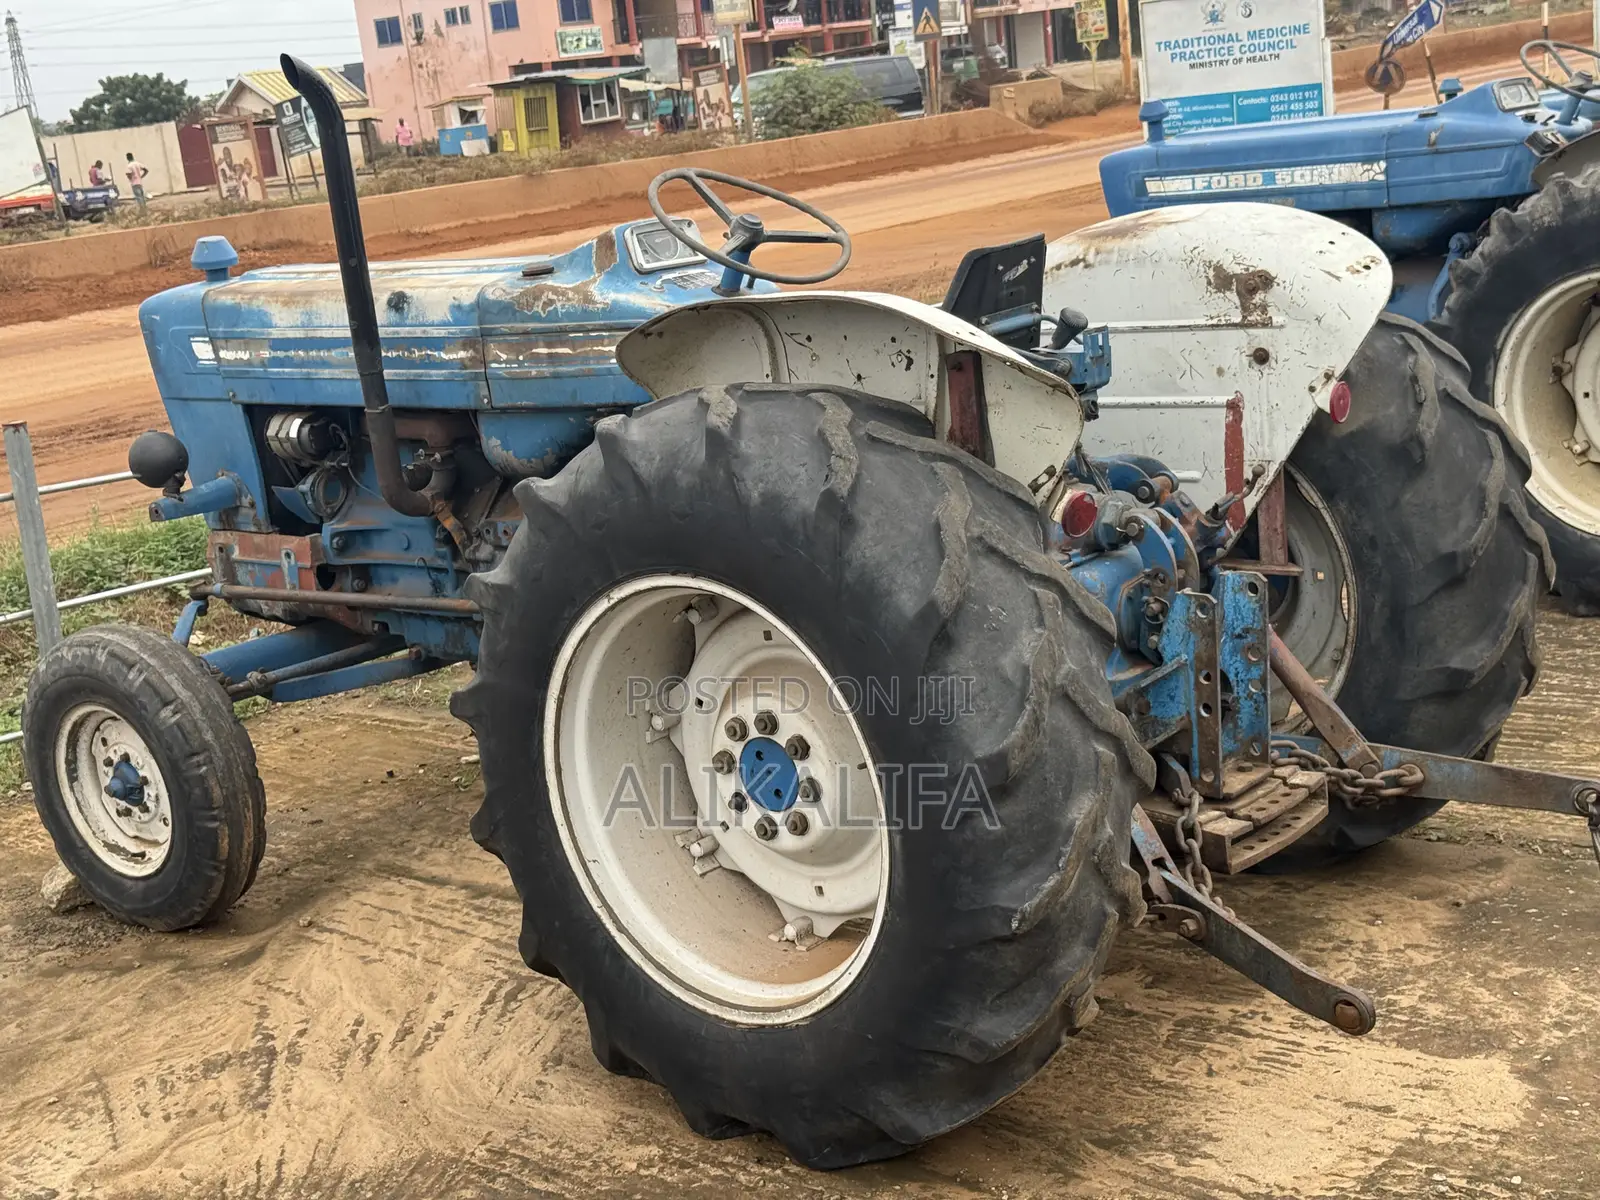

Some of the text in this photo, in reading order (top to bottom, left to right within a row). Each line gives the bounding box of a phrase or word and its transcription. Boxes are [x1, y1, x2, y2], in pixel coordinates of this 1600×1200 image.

[1155, 22, 1311, 53] TRADITIONAL MEDICINE
[1170, 38, 1297, 63] PRACTICE COUNCIL
[1188, 53, 1280, 70] MINISTRY OF HEALTH
[1238, 90, 1319, 106] Contacts: 0243 012 917
[1270, 104, 1288, 113] 0541
[1194, 173, 1263, 190] FORD
